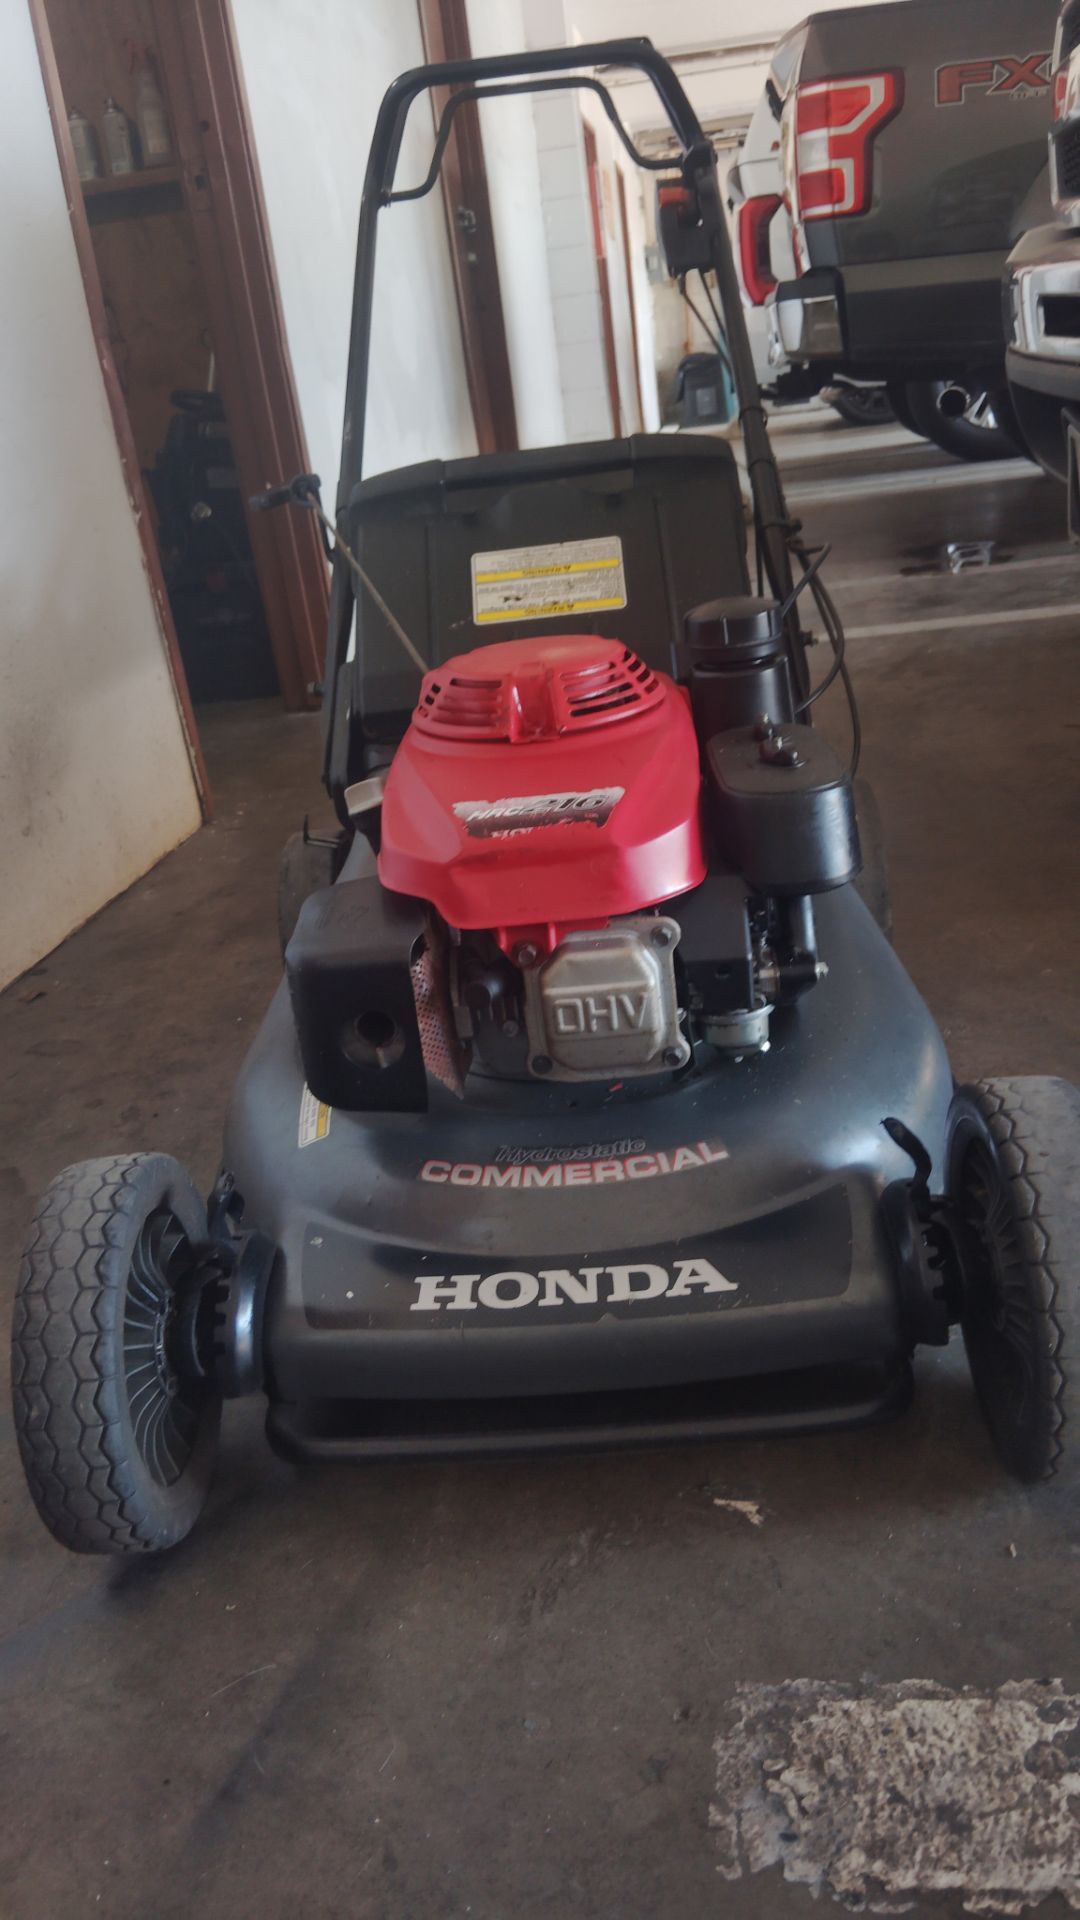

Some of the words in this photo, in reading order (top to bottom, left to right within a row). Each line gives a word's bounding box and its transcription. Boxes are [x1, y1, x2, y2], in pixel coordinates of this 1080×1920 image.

[935, 51, 1053, 107] FX
[554, 992, 648, 1033] OHV
[420, 1142, 729, 1188] COMMERCIAL
[495, 1138, 647, 1165] Hydrostatic
[409, 1258, 738, 1311] HONDA
